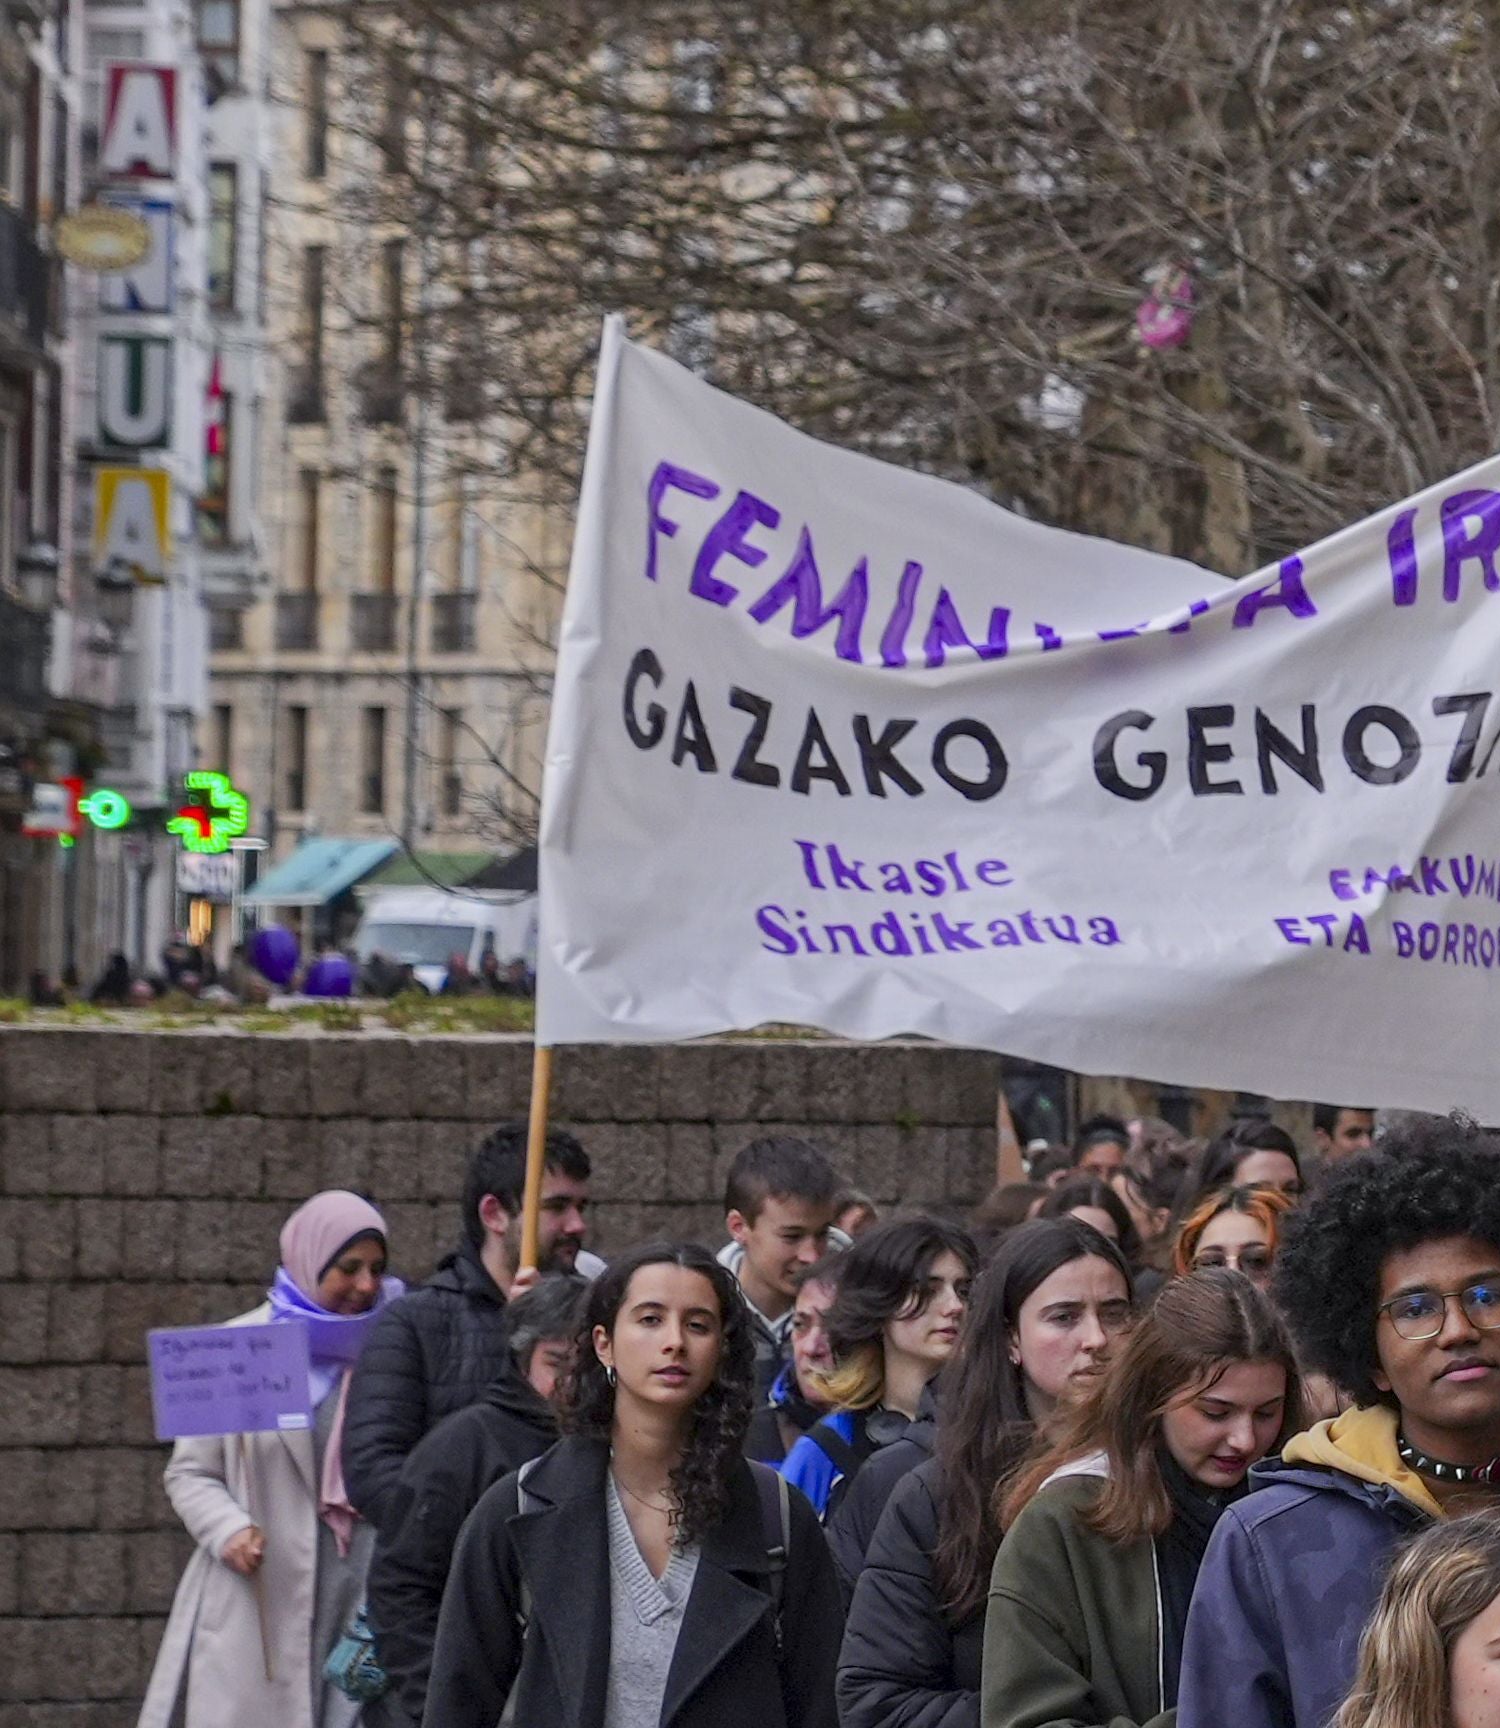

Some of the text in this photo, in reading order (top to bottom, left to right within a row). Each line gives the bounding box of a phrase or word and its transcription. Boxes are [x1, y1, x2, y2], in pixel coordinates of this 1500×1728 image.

[623, 649, 1009, 802] GAZAKO
[794, 840, 1015, 897] Ikasle
[754, 904, 1121, 960] Sindikatua
[1274, 911, 1372, 956] ETA
